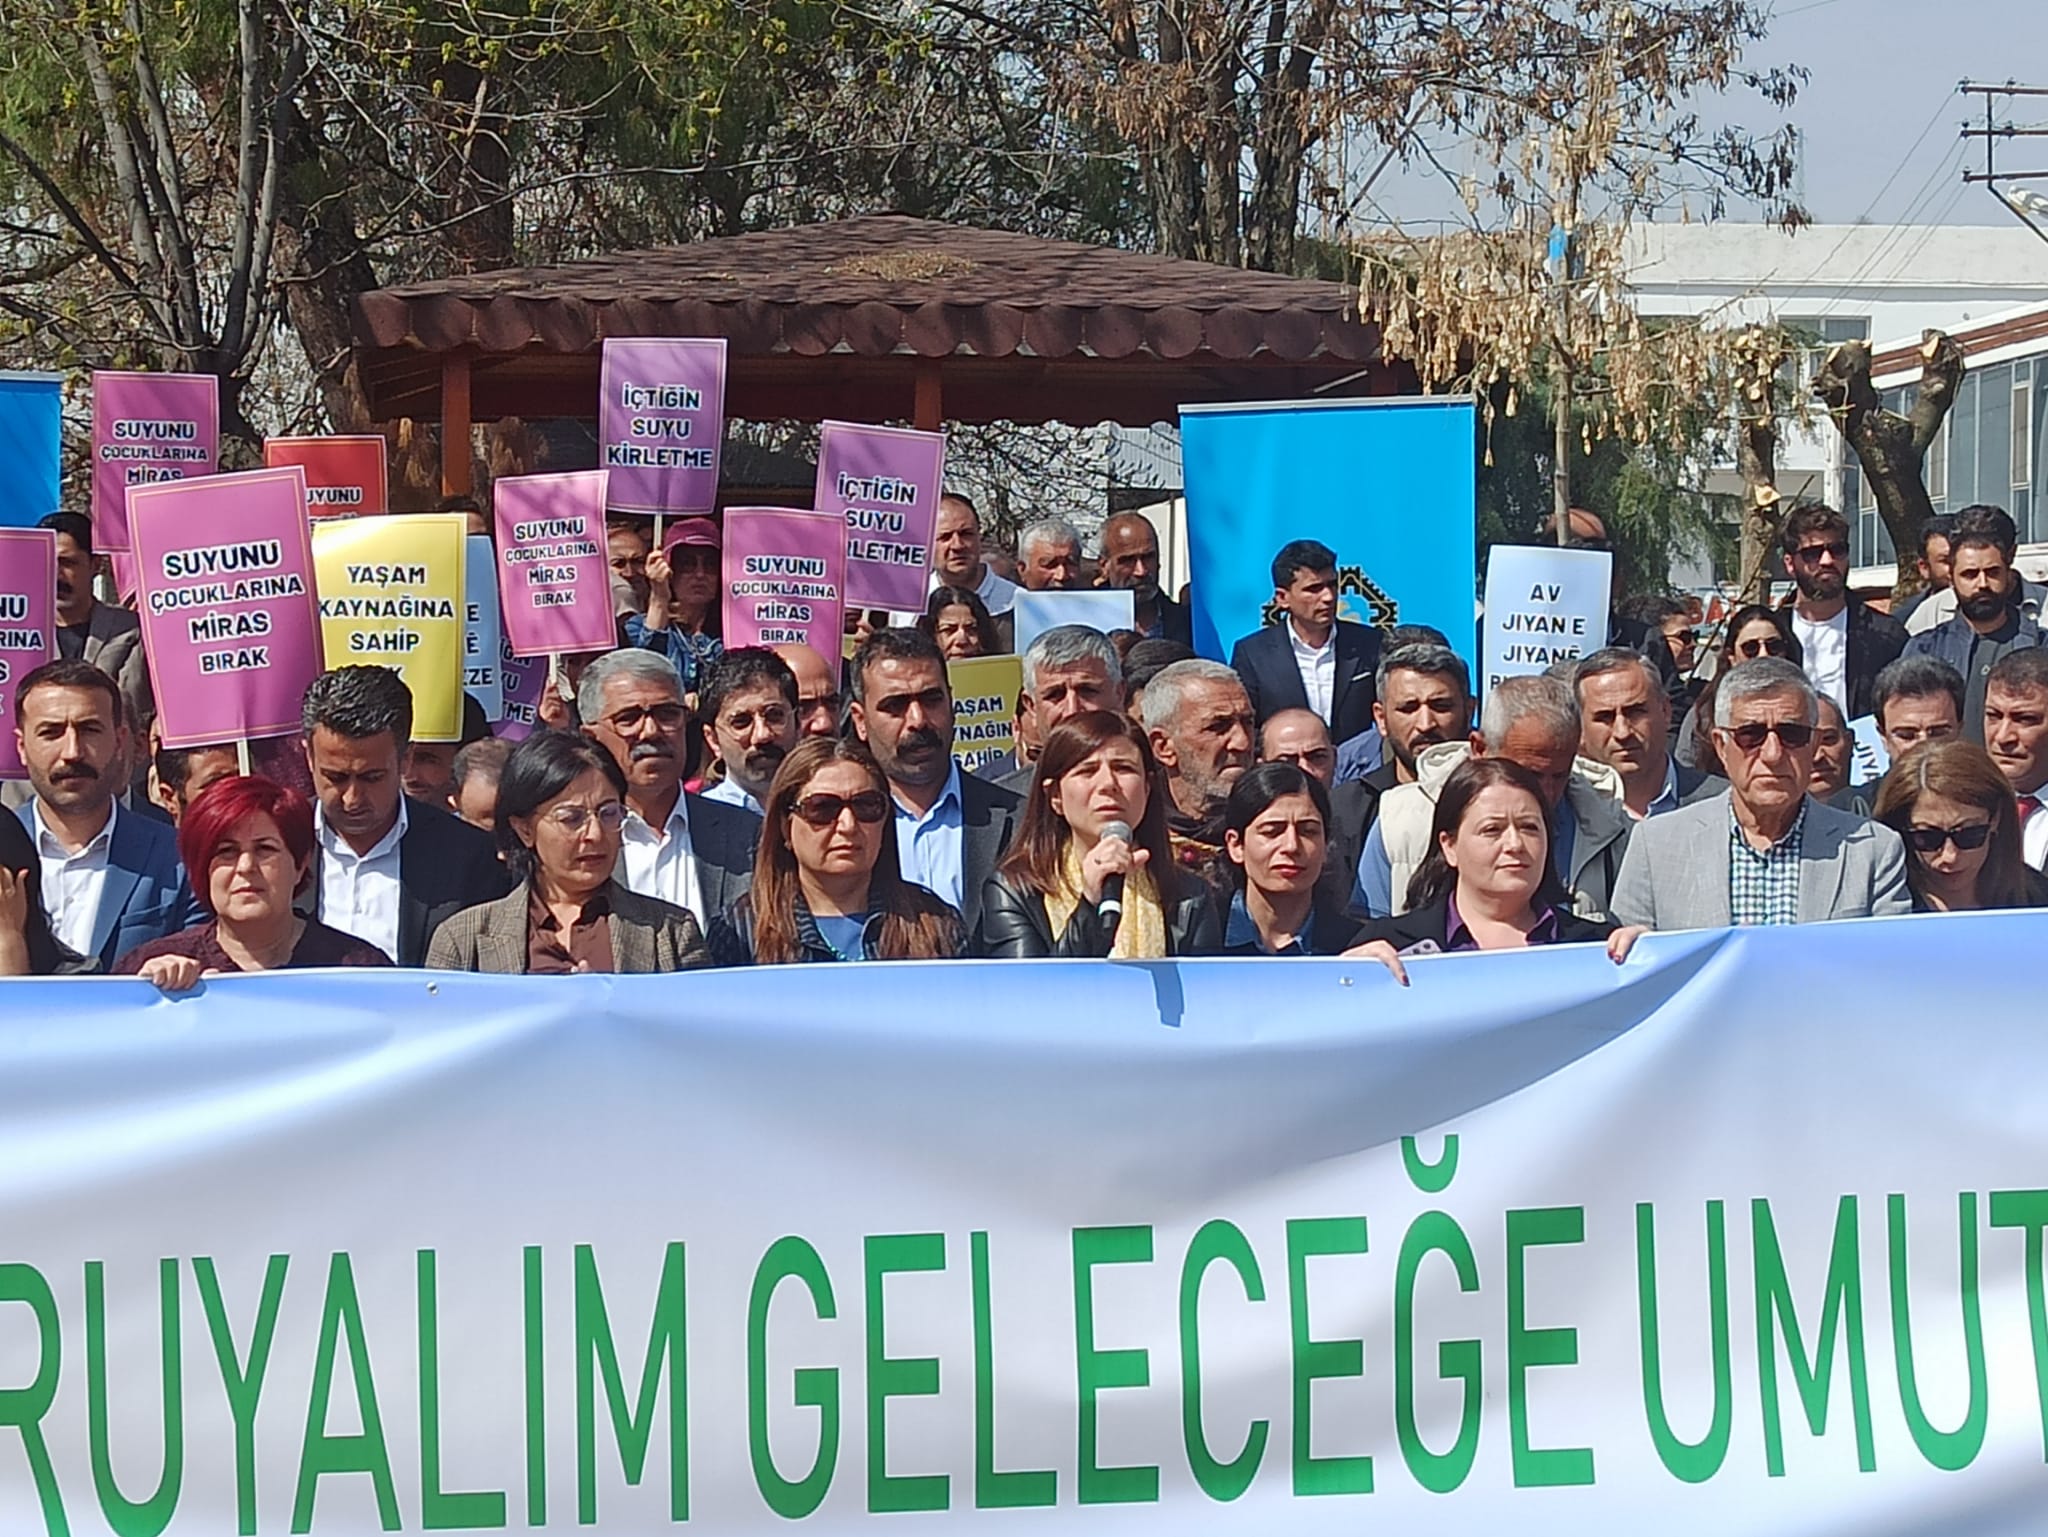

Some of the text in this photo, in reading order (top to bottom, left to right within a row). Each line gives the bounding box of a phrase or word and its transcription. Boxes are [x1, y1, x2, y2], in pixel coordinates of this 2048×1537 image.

[624, 384, 701, 410] İÇTİĞİN
[114, 421, 196, 440] SUYUNU
[632, 419, 690, 438] SUYU
[100, 446, 208, 462] ÇOCUKLARINA
[607, 445, 713, 468] KİRLETME
[837, 473, 916, 504] İÇTİĞİN
[515, 518, 585, 540] SUYUNU
[845, 509, 903, 532] SUYU
[165, 542, 280, 577] SUYUNU
[505, 543, 598, 563] ÇOCUKLARINA
[347, 564, 426, 587] YAŞAM
[528, 565, 576, 585] MİRAS
[744, 557, 825, 577] SUYUNU
[150, 576, 303, 614] ÇOCUKLARINA
[534, 590, 576, 607] BIRAK
[732, 582, 836, 600] ÇOCUKLARINA
[1530, 584, 1561, 602] AV
[319, 595, 454, 618] KAYNAĞINA
[757, 602, 811, 621] MİRAS
[191, 612, 270, 641] MİRAS
[1502, 613, 1586, 635] JIYAN E
[350, 627, 420, 651] SAHİP
[760, 629, 807, 643] BIRAK
[202, 649, 269, 673] BIRAK
[954, 695, 1003, 717] AŞAM
[747, 1133, 1596, 1519] GELECEĞE
